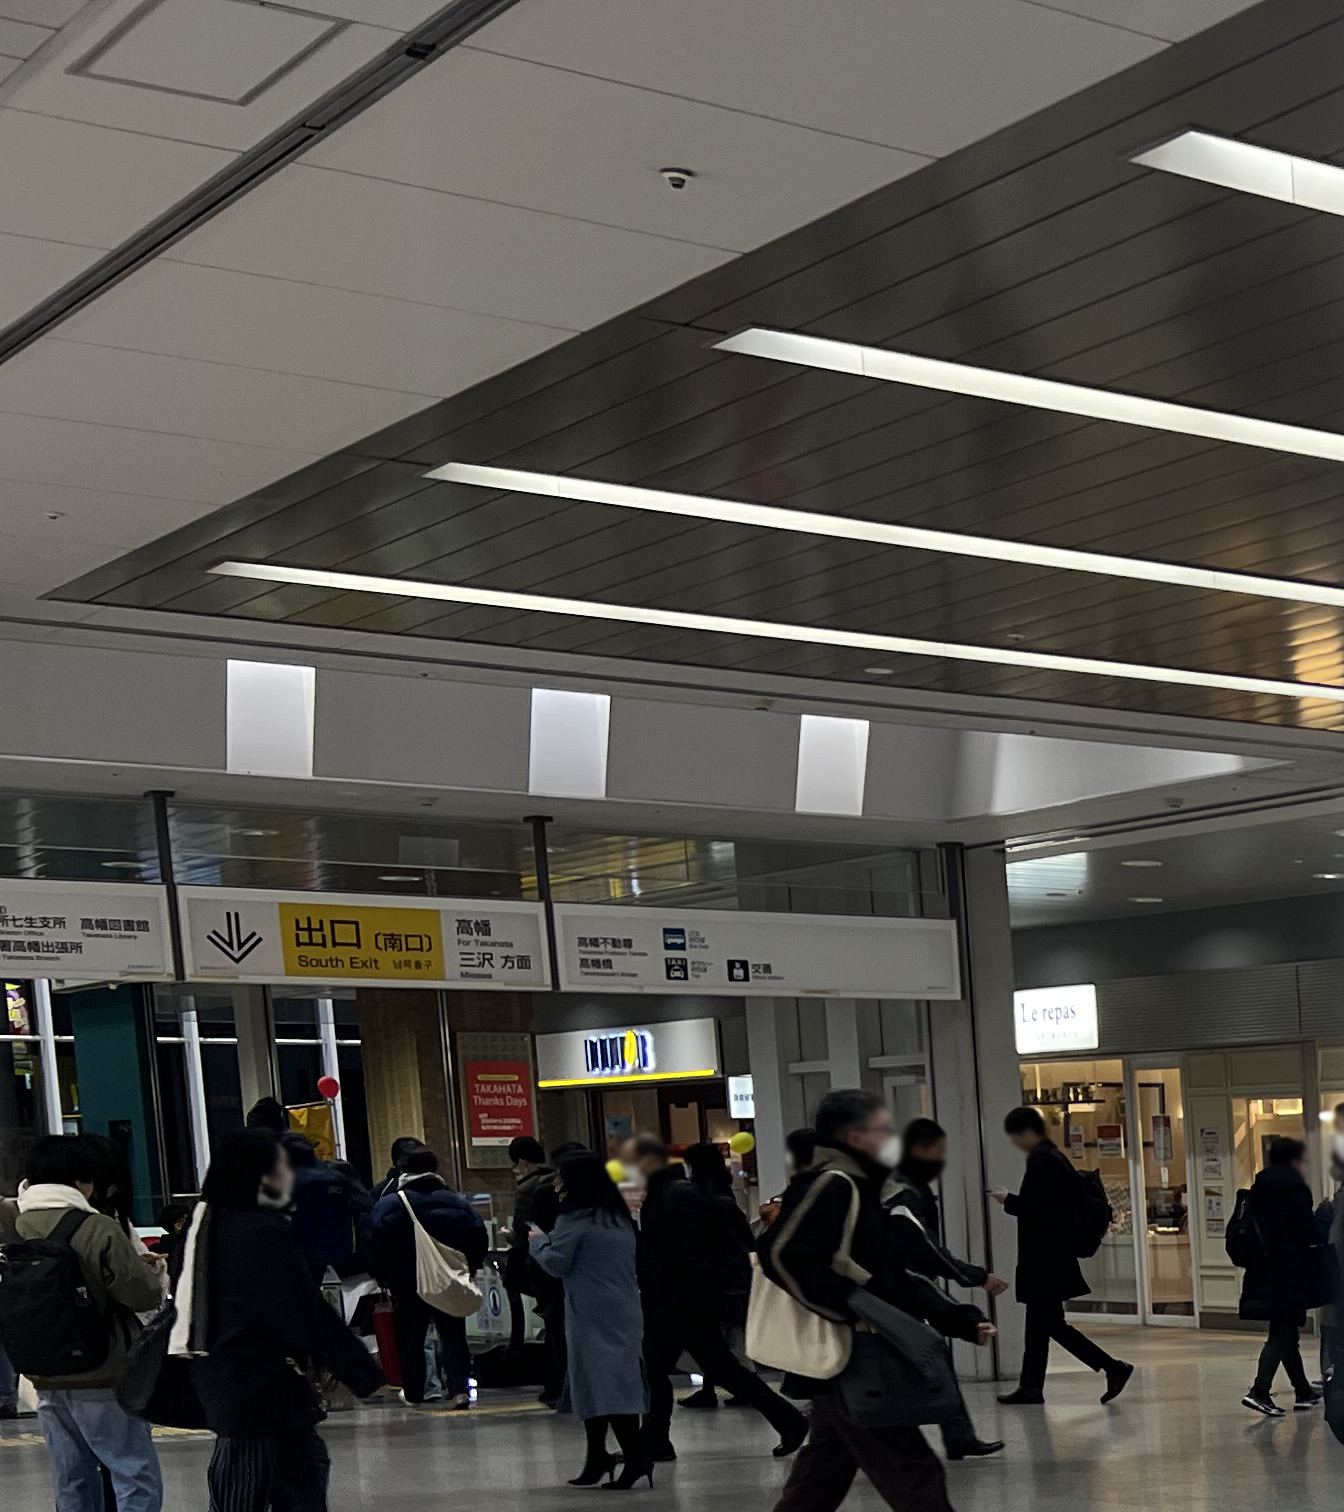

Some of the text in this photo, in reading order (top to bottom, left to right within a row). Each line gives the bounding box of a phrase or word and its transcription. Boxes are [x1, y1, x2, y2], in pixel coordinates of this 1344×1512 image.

[294, 916, 362, 949] 出口
[455, 919, 492, 937] 高幡
[297, 955, 380, 970] South Exit
[459, 951, 532, 970] 三沢 方面
[1021, 1003, 1076, 1026] Le repas
[474, 1083, 524, 1094] TAKAHATA
[473, 1095, 528, 1108] Thanks Days
